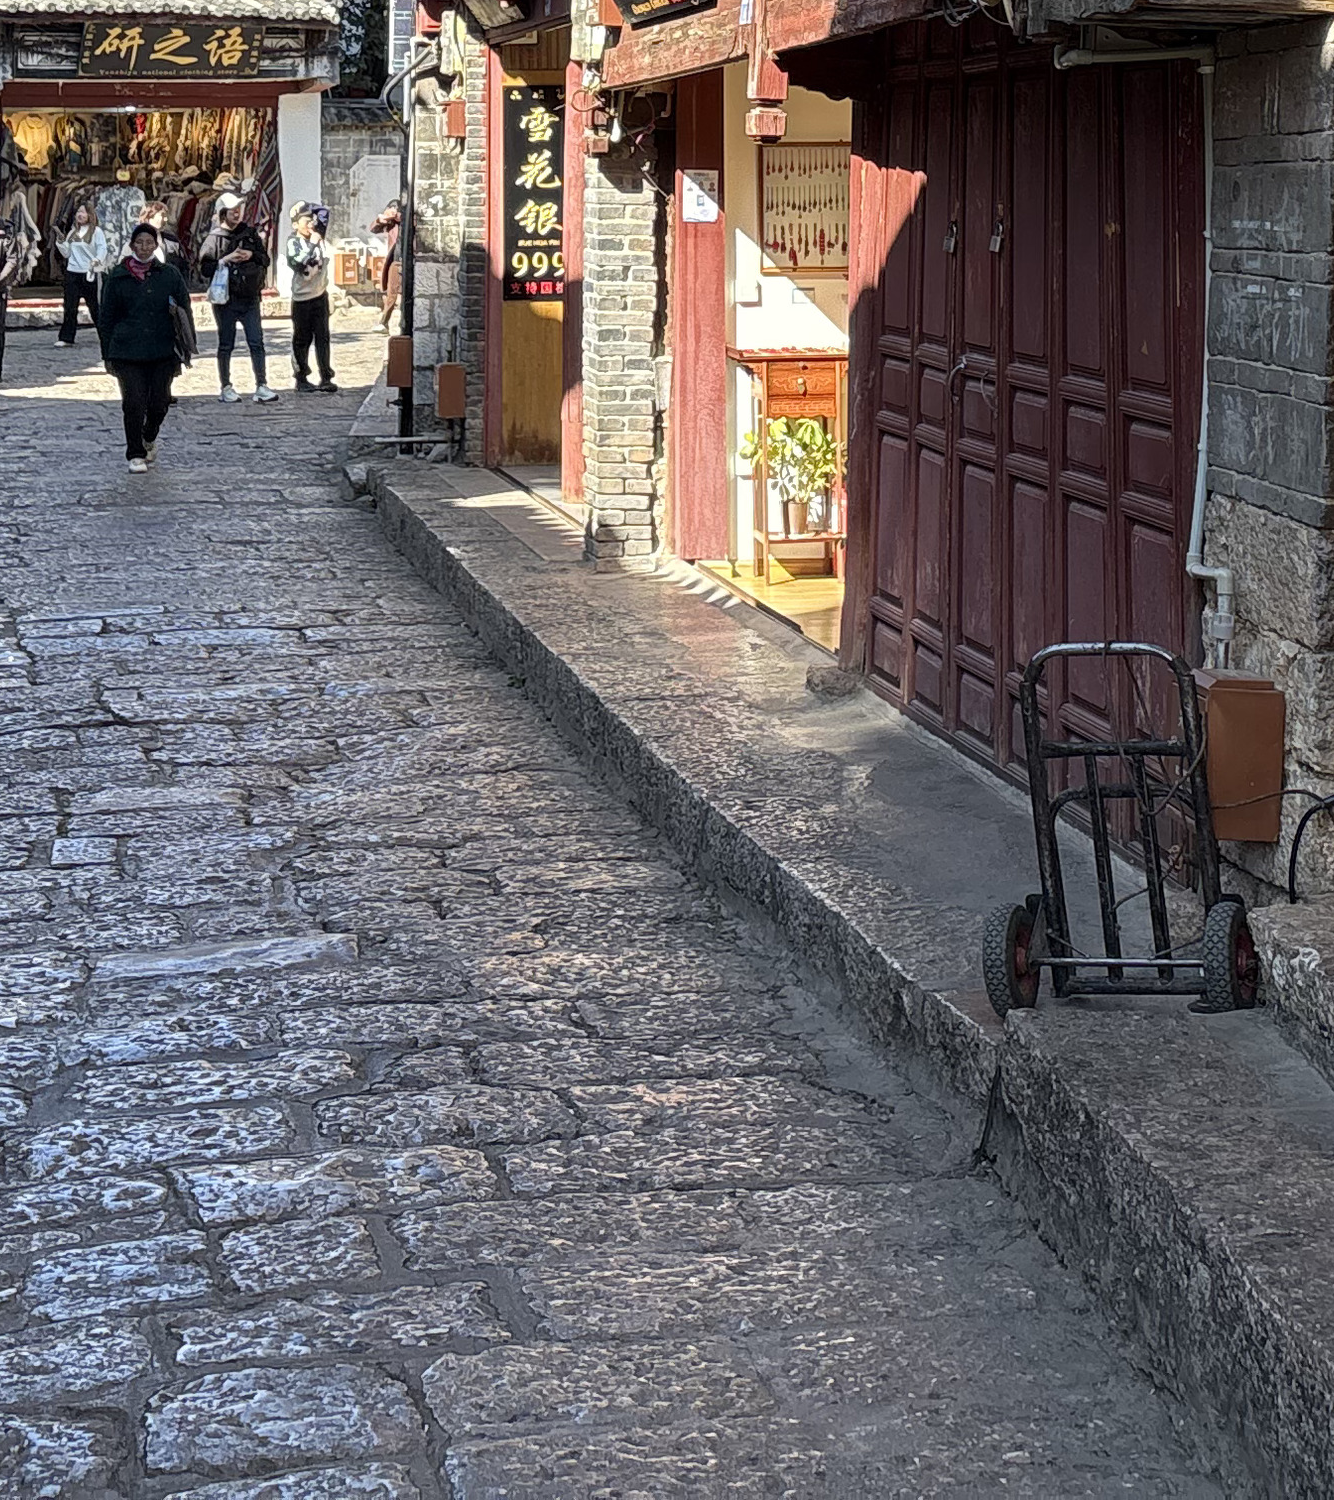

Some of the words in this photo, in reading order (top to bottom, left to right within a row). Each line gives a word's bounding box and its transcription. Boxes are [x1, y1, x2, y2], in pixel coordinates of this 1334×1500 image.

[94, 26, 250, 71] 研之语
[514, 106, 563, 236] 雪花银
